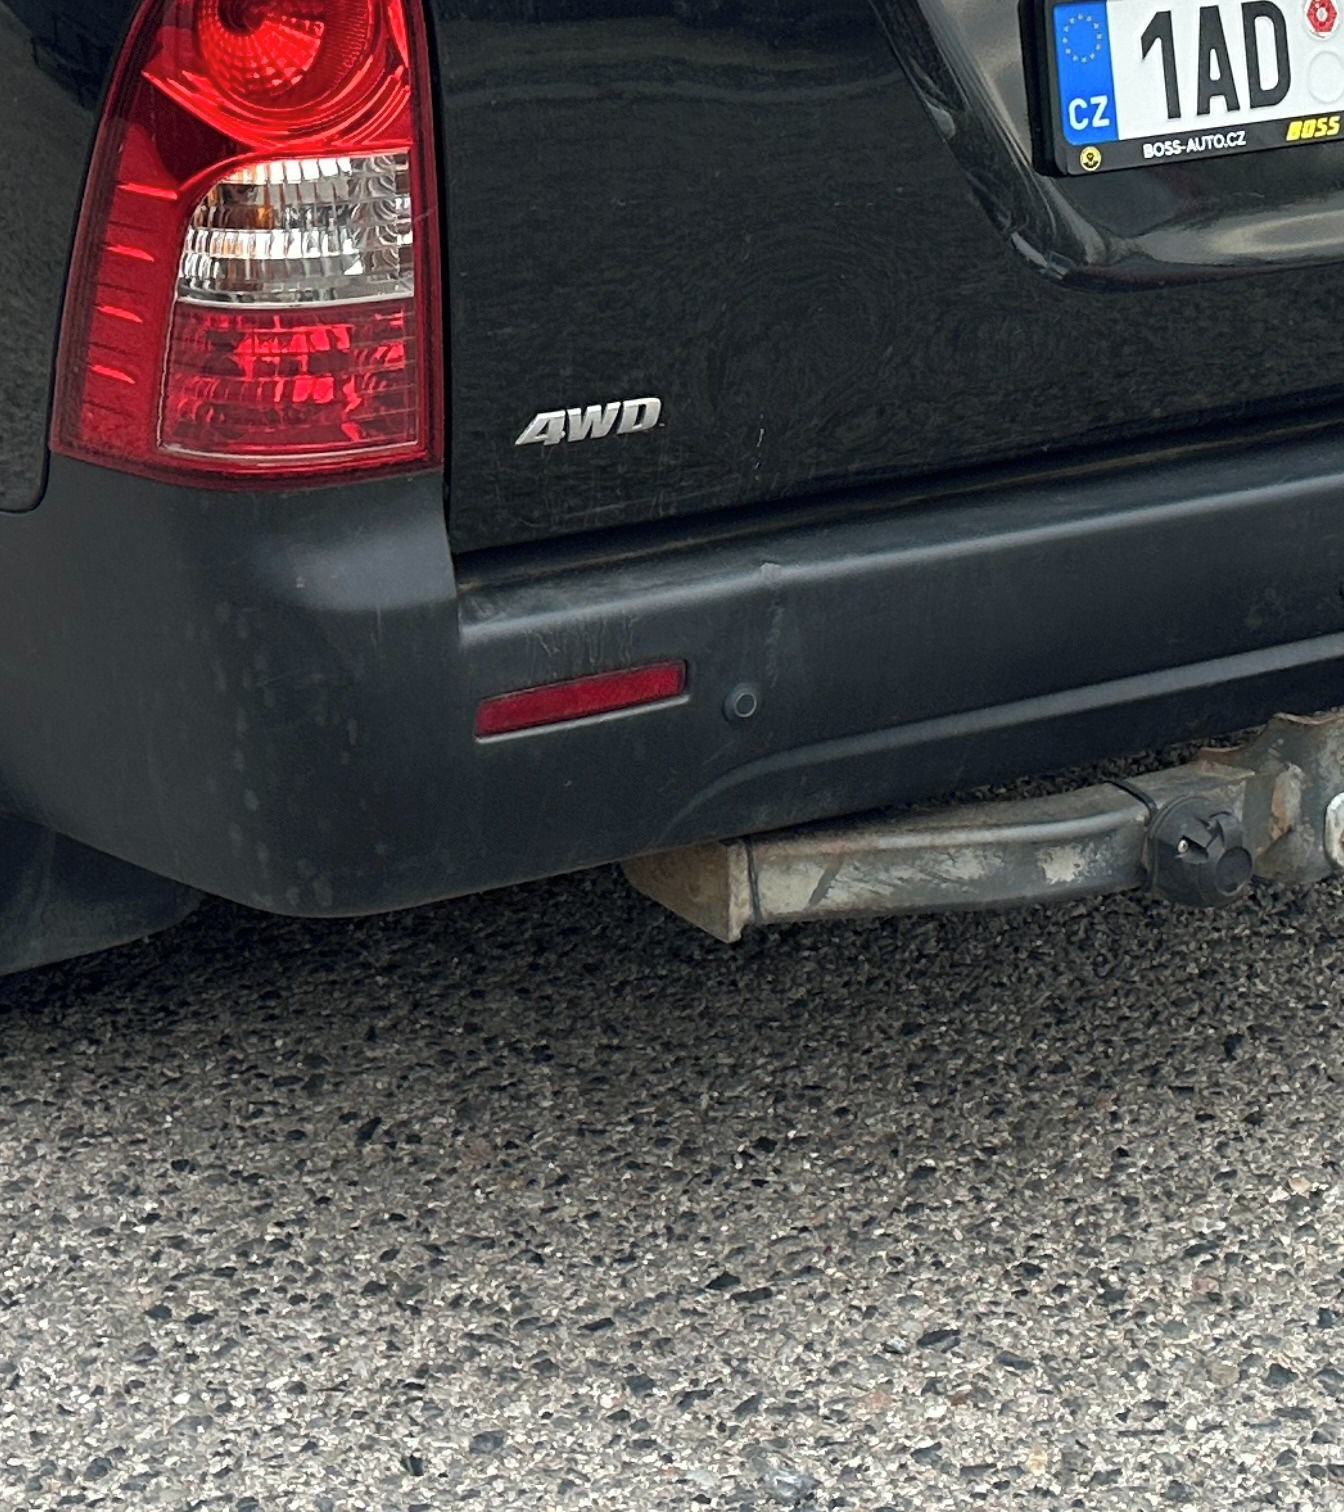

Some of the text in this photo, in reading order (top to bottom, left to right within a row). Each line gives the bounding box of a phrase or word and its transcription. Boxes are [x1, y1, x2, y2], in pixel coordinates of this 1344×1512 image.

[1067, 95, 1111, 131] CZ
[1286, 114, 1341, 142] BOSS
[1142, 130, 1248, 160] BOSS-AUTO.CZ
[514, 396, 662, 447] 4WD
